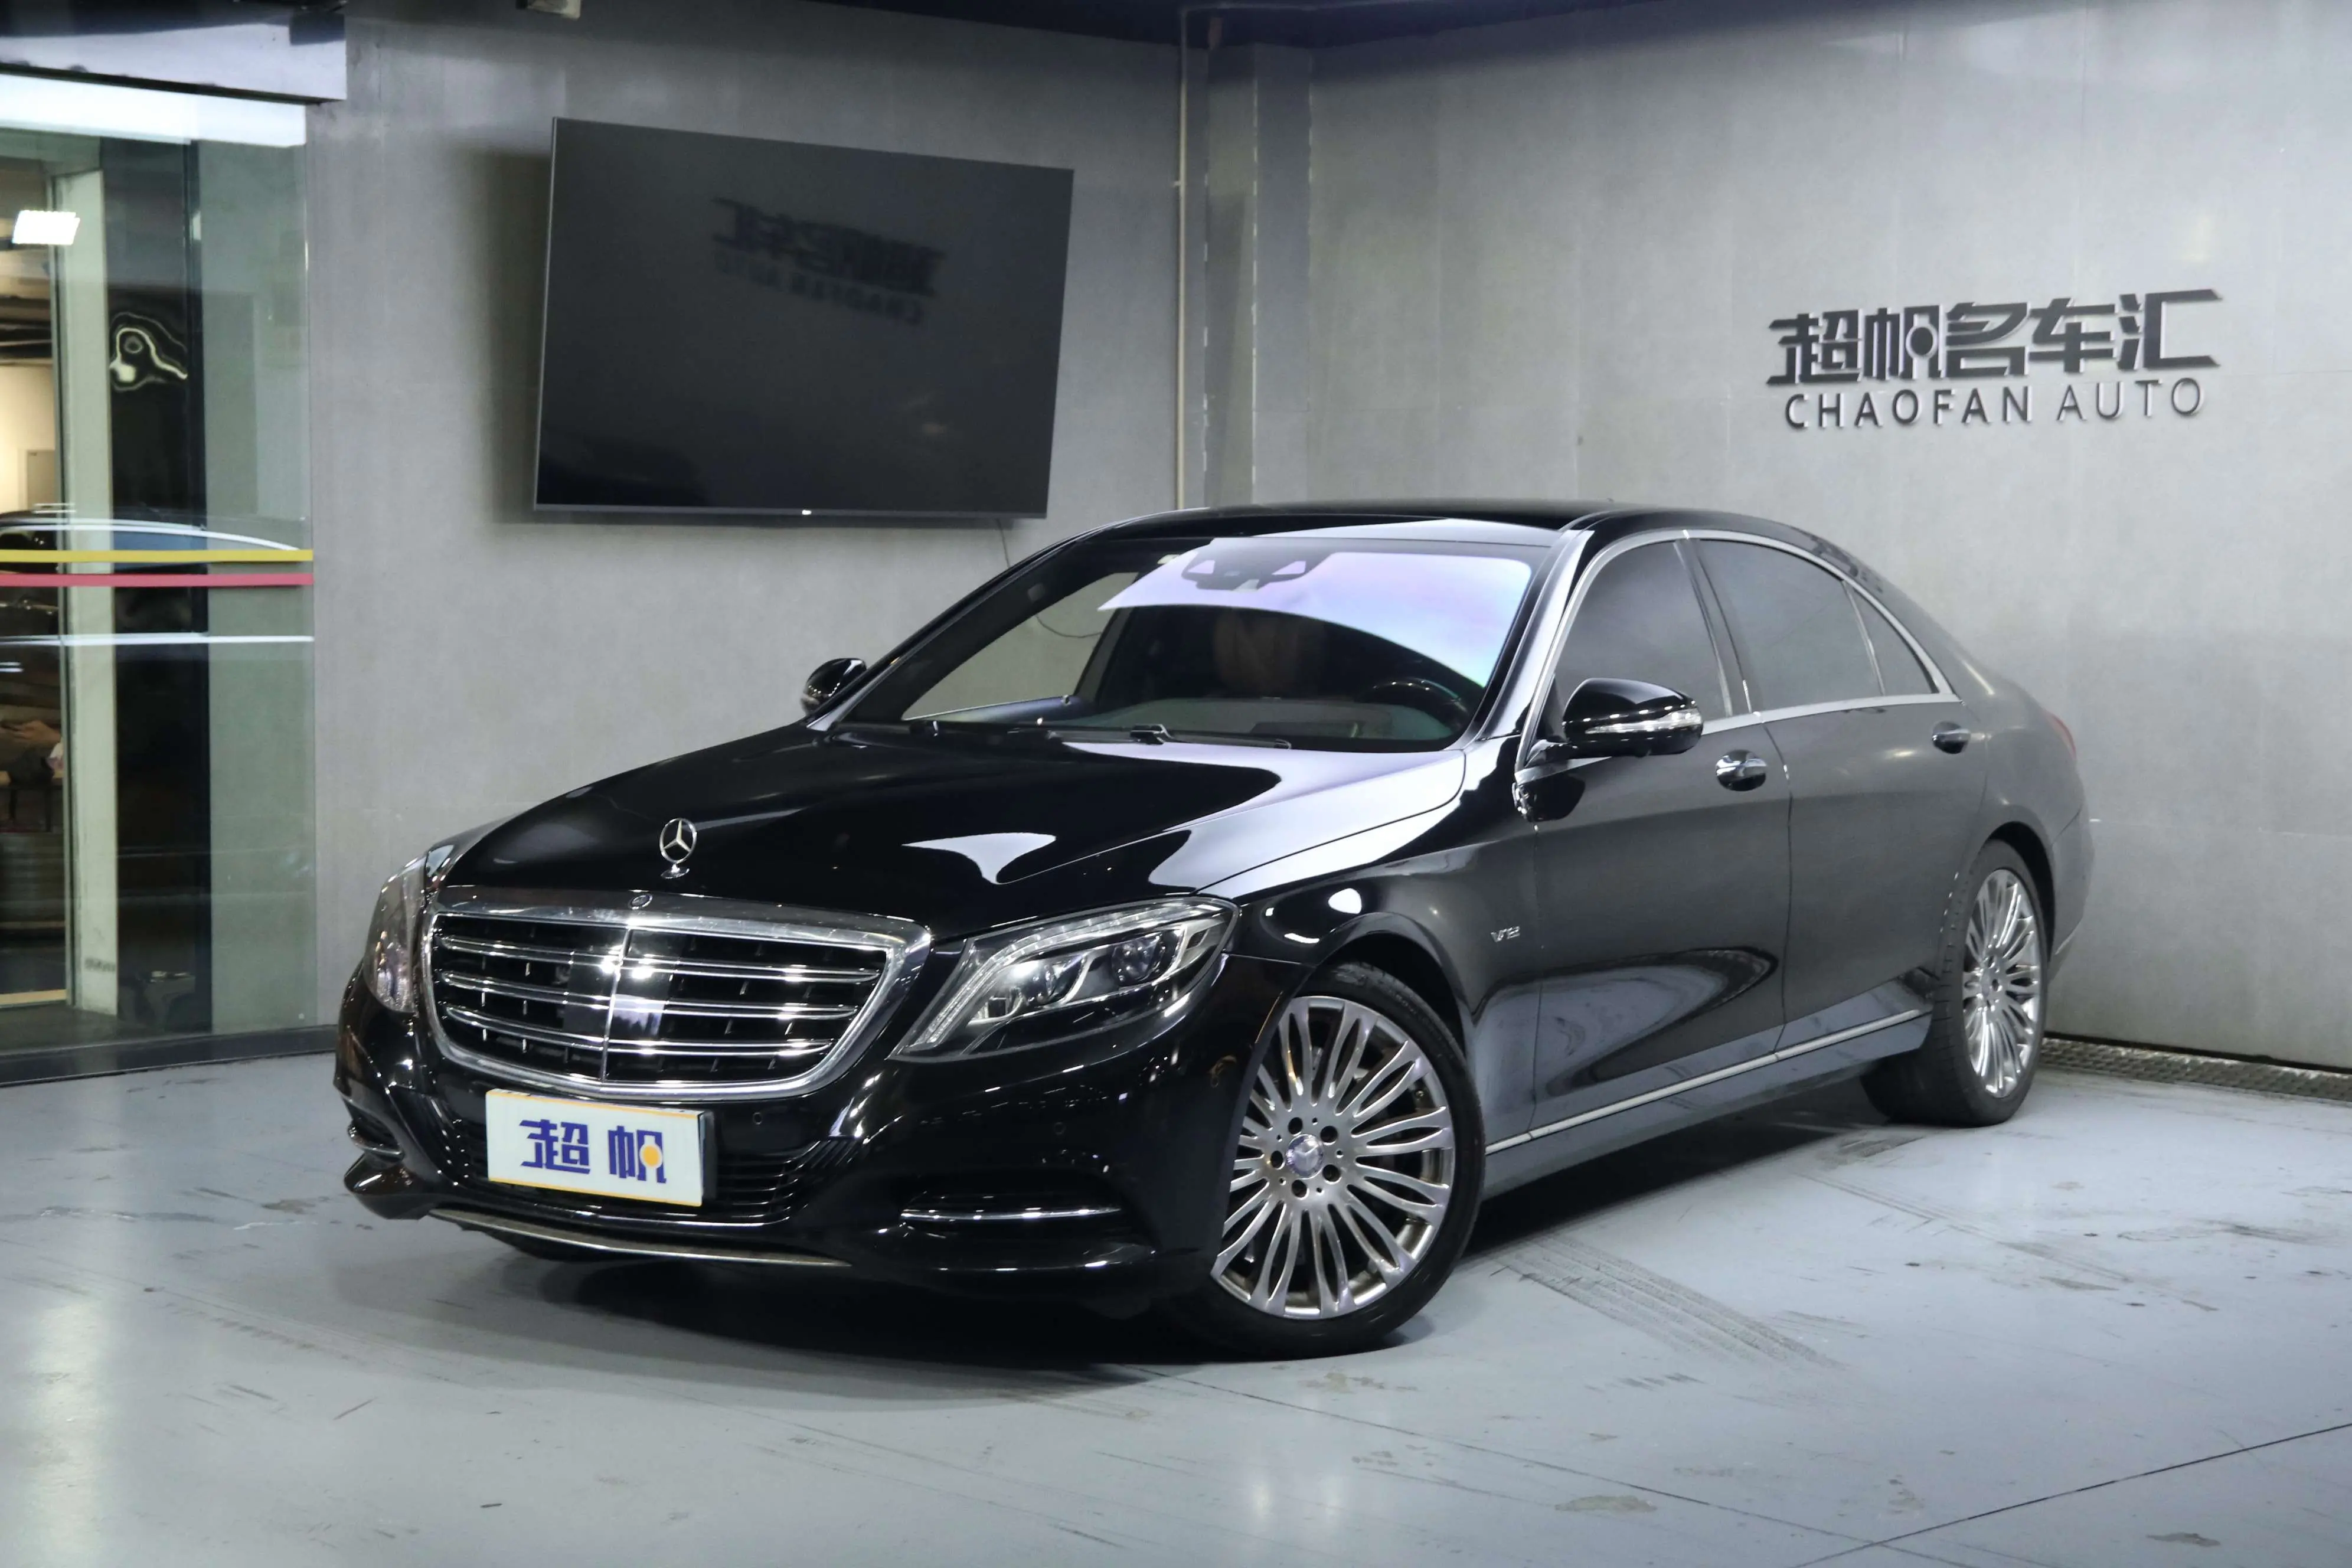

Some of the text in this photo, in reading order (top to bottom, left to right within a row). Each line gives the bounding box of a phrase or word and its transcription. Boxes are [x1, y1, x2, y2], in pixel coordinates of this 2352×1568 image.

[1767, 289, 2222, 385] 超帆名车汇
[1785, 377, 2203, 429] CHAOFAN AUTO
